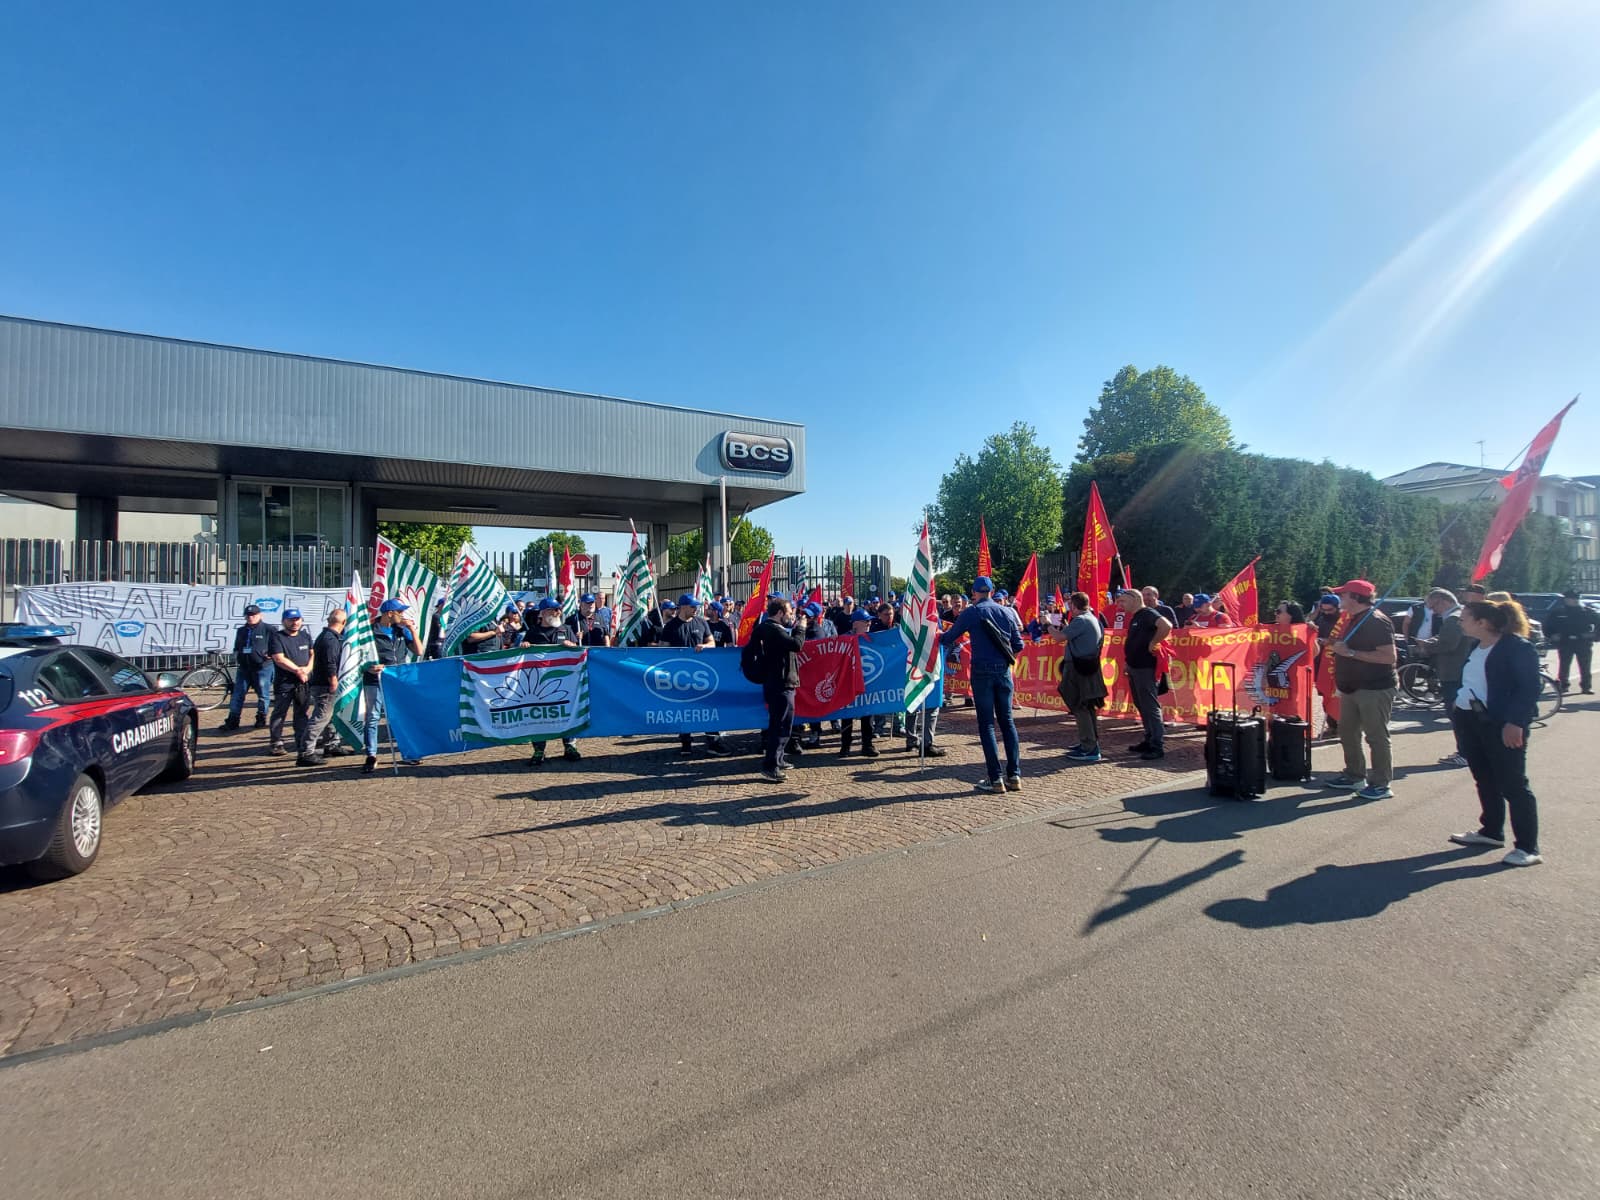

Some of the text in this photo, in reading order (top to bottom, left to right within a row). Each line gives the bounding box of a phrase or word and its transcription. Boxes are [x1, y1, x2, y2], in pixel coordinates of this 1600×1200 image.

[729, 441, 789, 462] BCS
[654, 669, 711, 691] BCS
[18, 688, 53, 707] 112
[491, 705, 571, 724] FIM-CISL
[646, 708, 720, 724] RASAERBA
[112, 716, 173, 754] CARABINIERI
